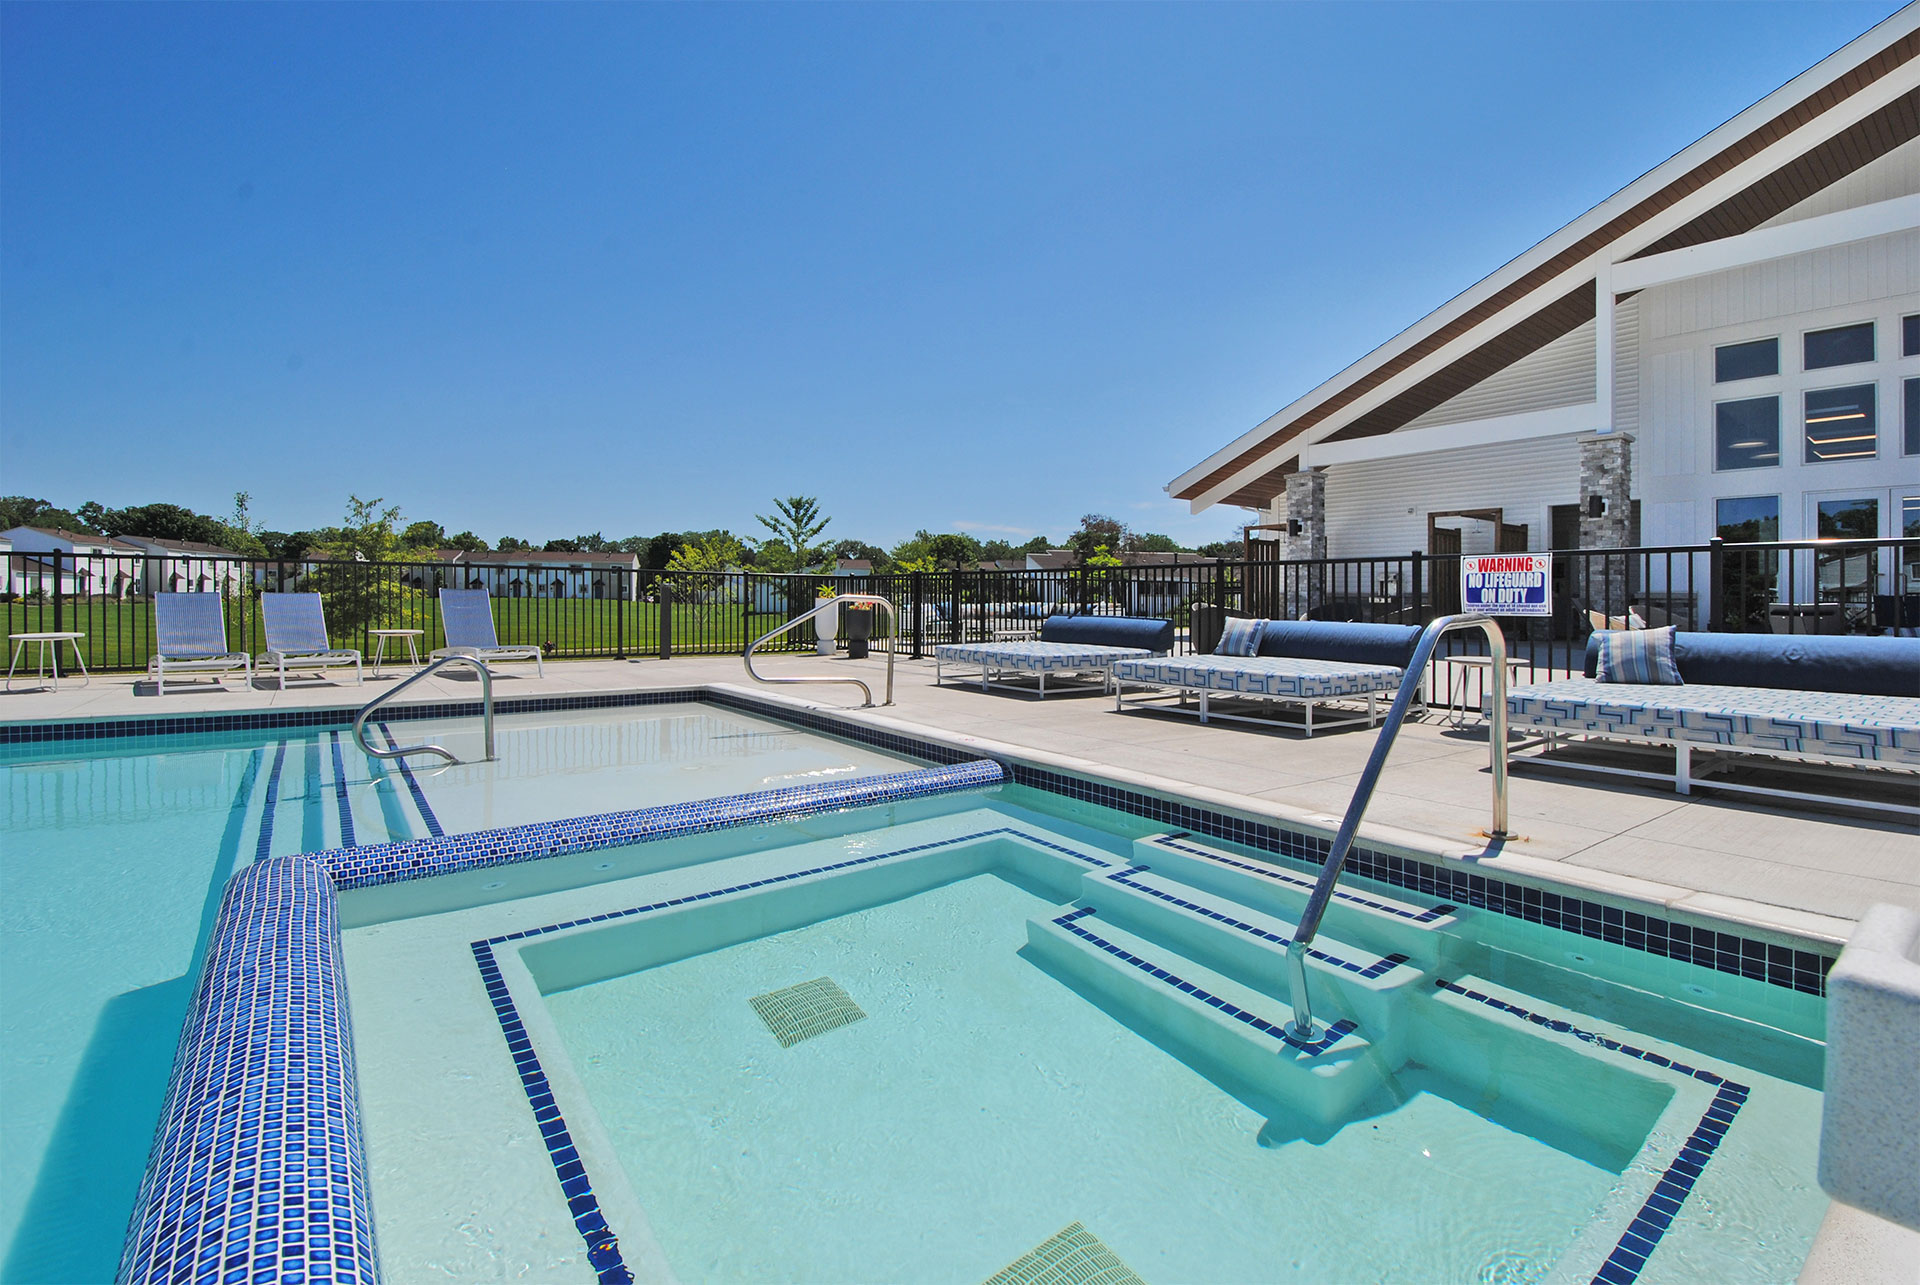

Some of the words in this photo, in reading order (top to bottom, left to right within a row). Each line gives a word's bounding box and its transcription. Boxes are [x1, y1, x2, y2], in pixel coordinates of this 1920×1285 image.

[1478, 557, 1533, 572] WARNING
[1468, 573, 1483, 588] NO
[1484, 572, 1542, 588] LIFEGUARD
[1481, 588, 1496, 603] ON
[1498, 588, 1527, 603] DUTY
